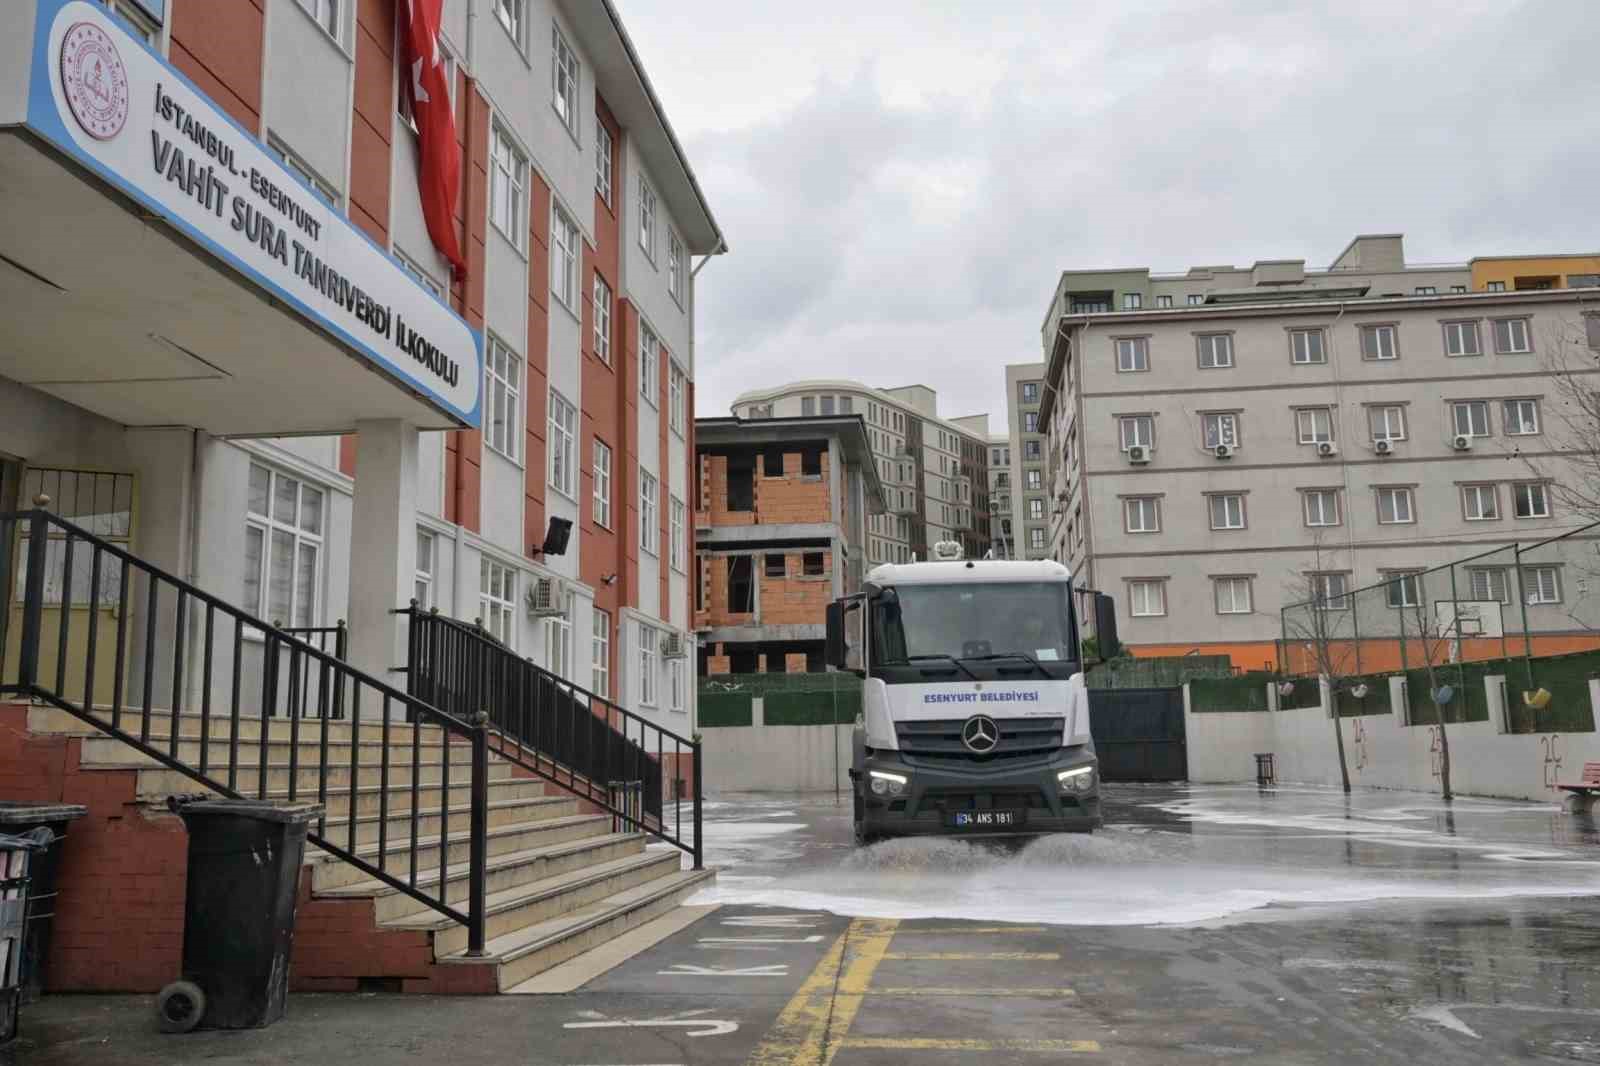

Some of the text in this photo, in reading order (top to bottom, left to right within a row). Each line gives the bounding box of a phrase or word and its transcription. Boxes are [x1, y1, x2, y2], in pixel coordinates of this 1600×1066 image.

[155, 82, 238, 175] İSTANBUL
[250, 167, 321, 241] ESENYURT
[151, 129, 459, 387] VAHİT SURA TANRIVERDİ İLKOKULU
[924, 689, 1039, 704] ESENYURT BELEDİYESİ
[962, 813, 974, 824] 34
[977, 813, 993, 824] ANS
